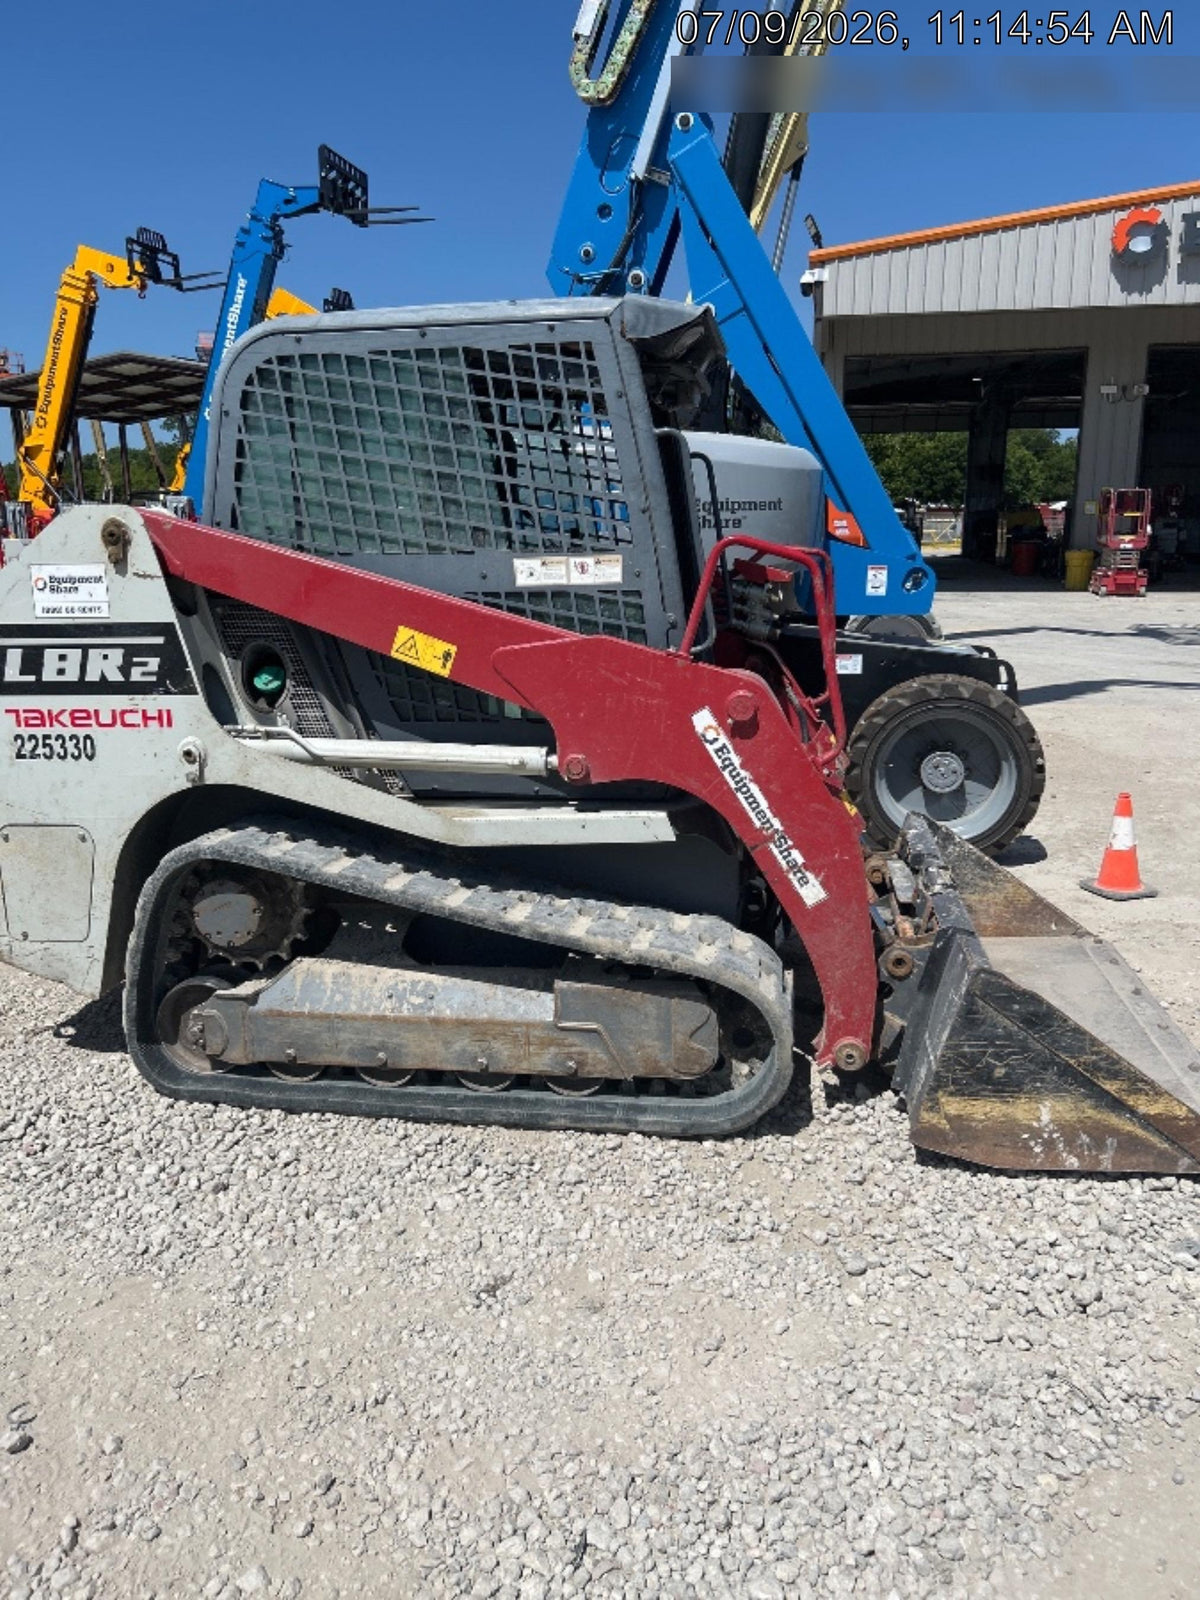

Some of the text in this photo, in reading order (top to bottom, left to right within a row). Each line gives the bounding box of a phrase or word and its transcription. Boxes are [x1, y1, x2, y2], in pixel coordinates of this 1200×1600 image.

[48, 574, 104, 586] Equipment
[48, 585, 79, 594] Share
[13, 733, 96, 762] 225330
